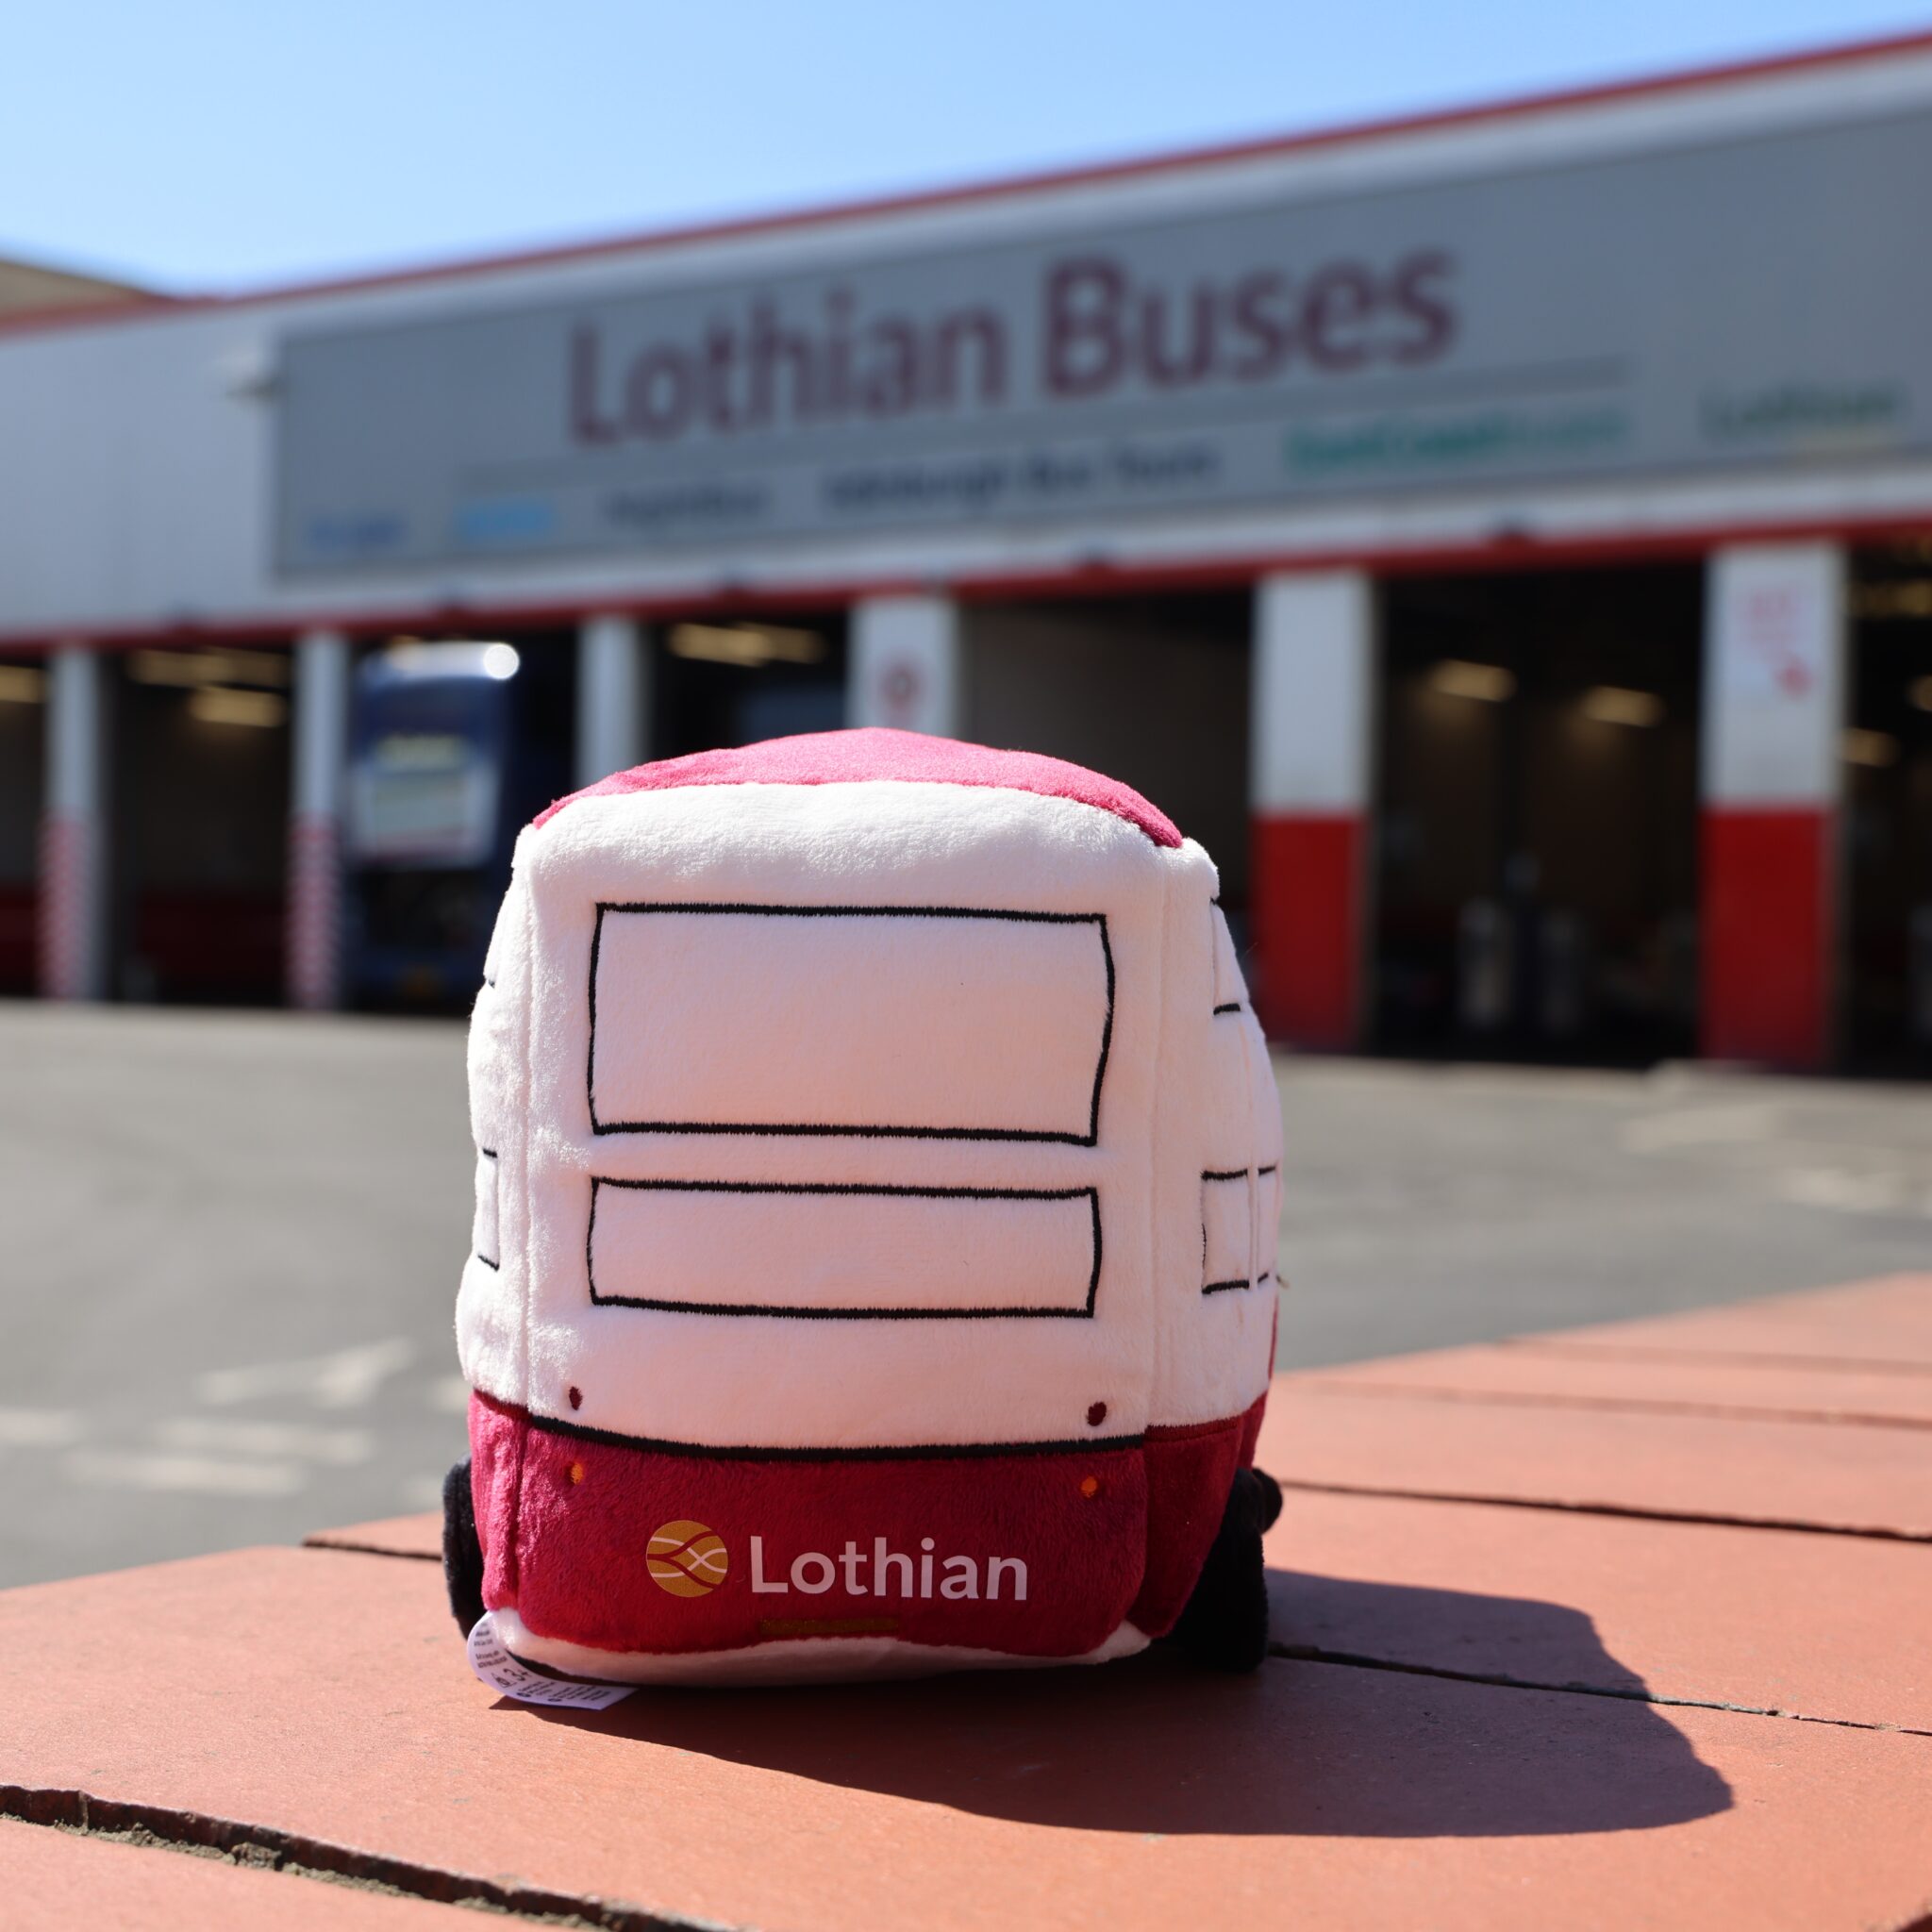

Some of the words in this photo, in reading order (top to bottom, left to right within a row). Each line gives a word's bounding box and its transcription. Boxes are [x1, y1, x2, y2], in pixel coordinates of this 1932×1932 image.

[568, 286, 1008, 447] Lothian
[1044, 246, 1461, 398] Buses
[750, 1535, 1028, 1602] Lothian
